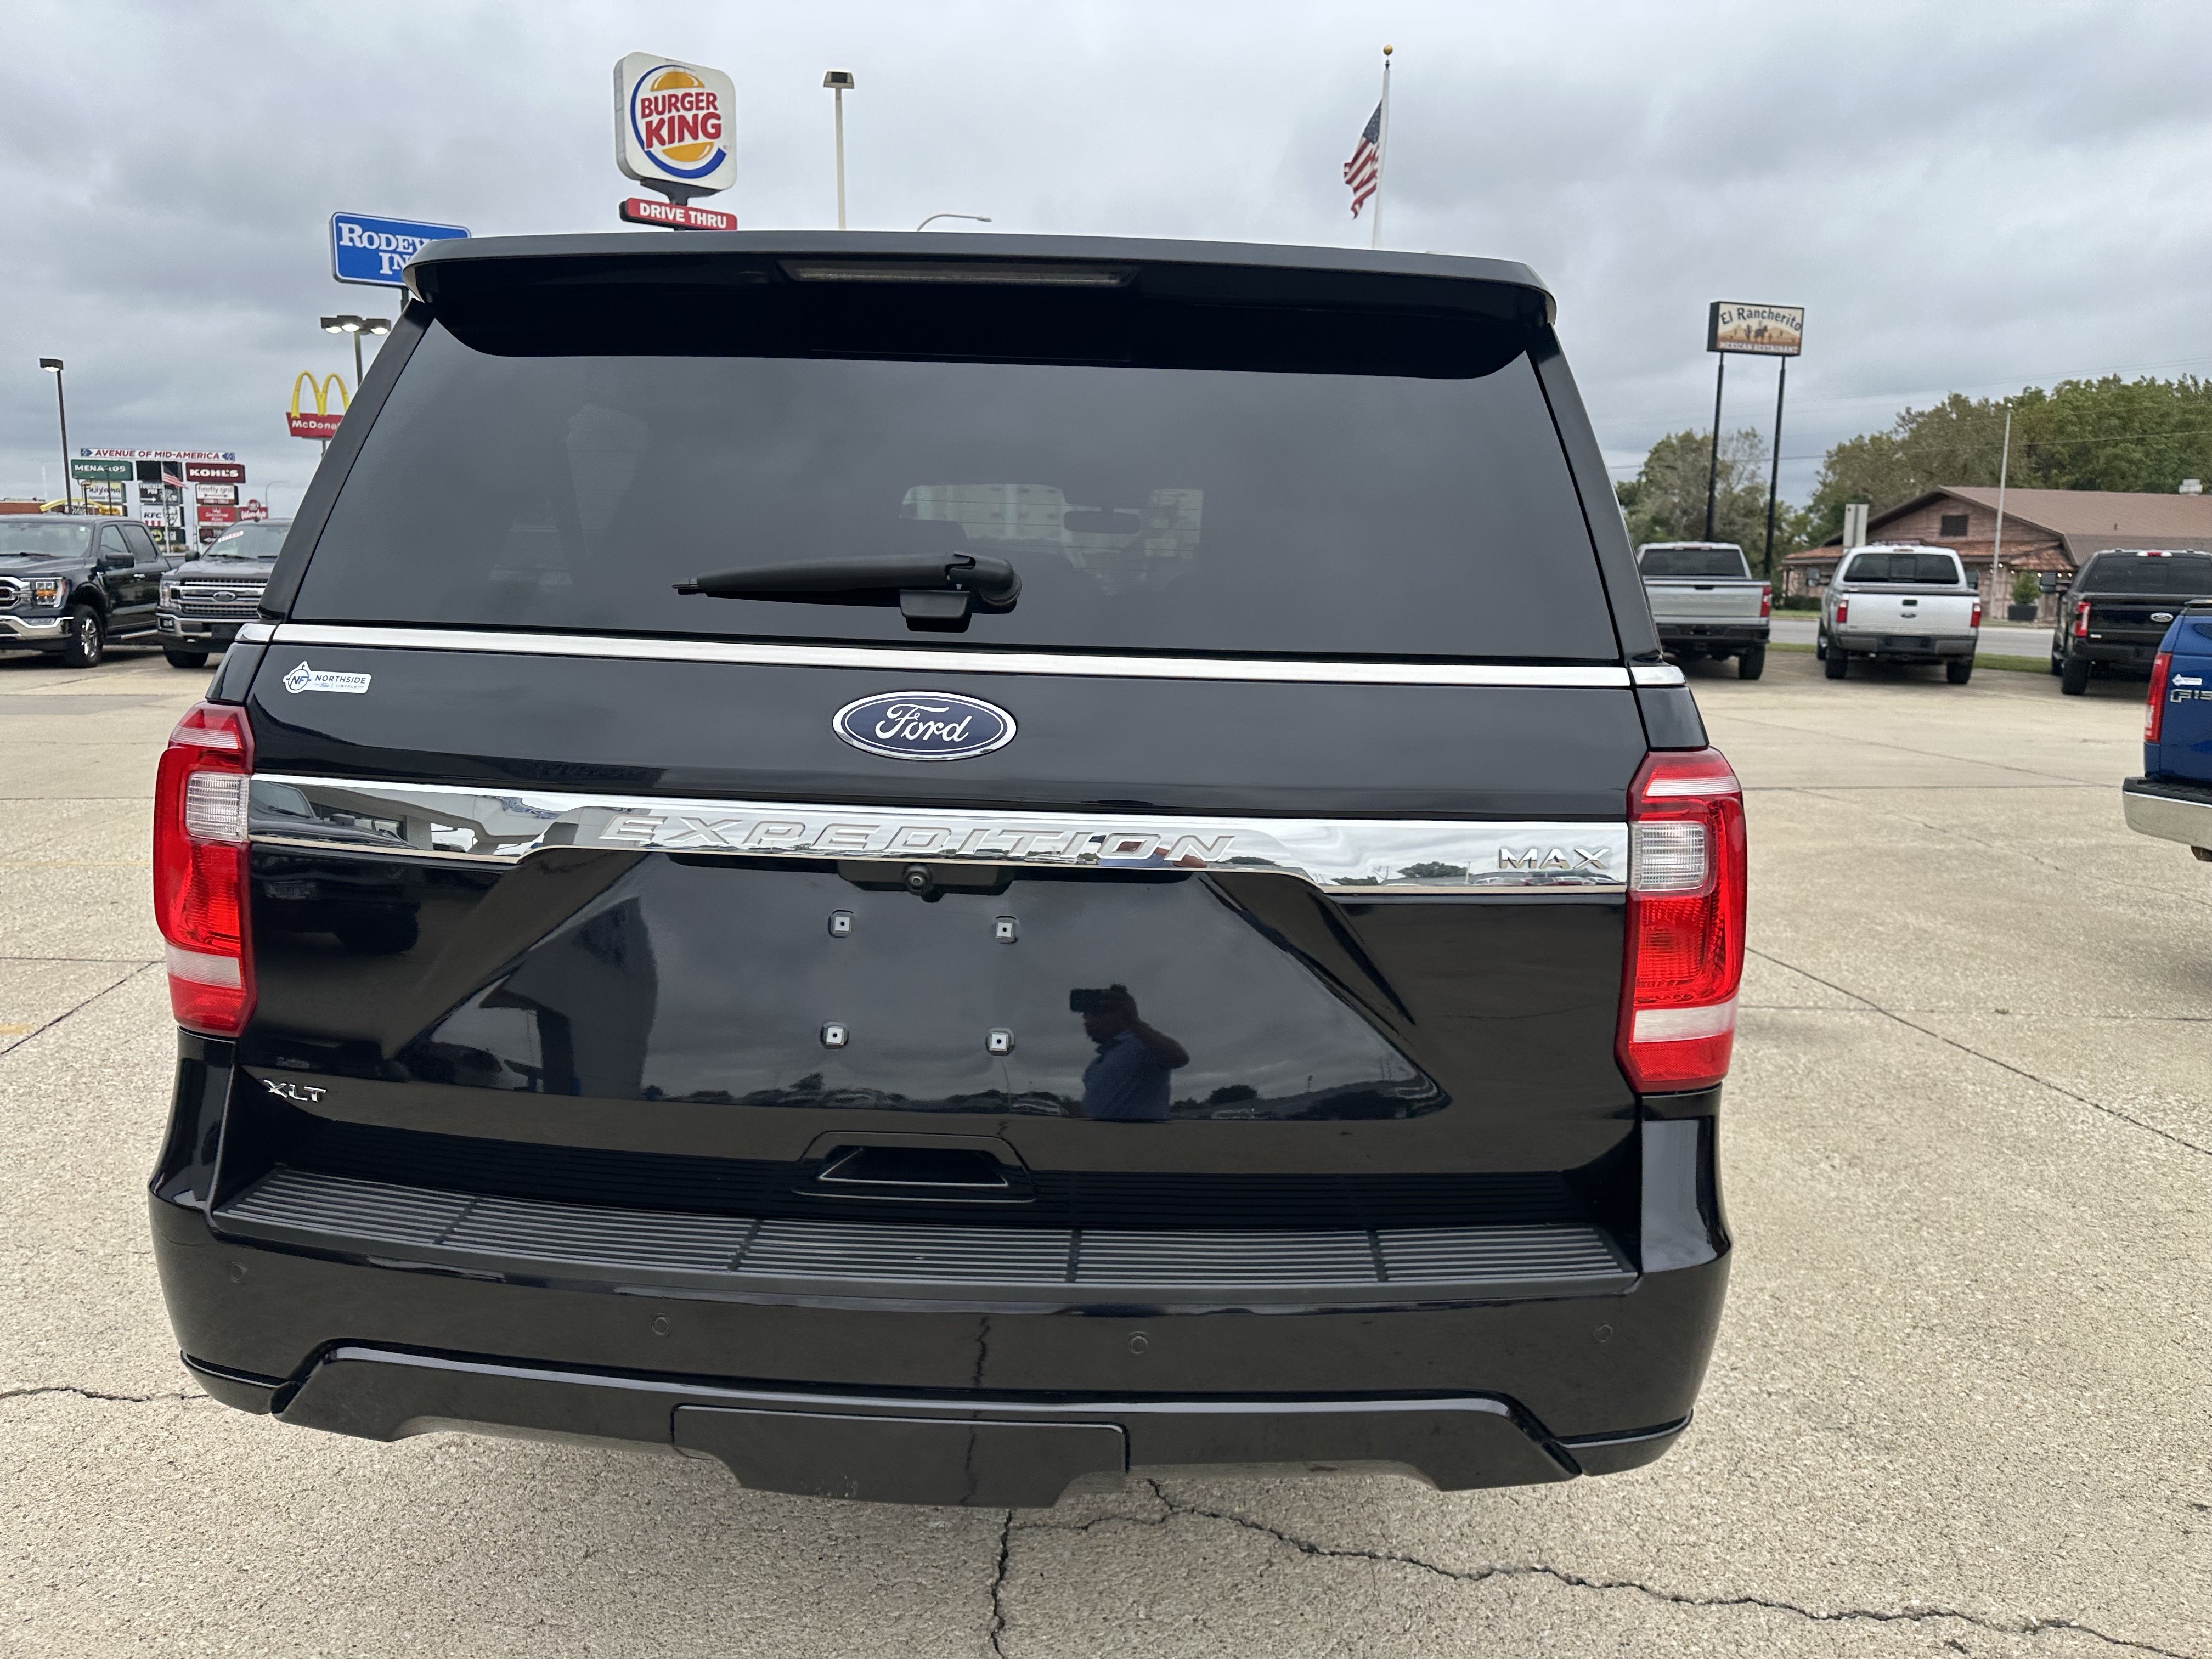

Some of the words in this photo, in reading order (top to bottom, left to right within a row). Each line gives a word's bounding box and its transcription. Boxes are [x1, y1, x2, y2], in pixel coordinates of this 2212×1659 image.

[640, 92, 718, 119] BURGER
[645, 112, 721, 149] KING
[639, 203, 685, 222] DRIVE
[689, 210, 727, 229] THRU
[1720, 311, 1733, 325] El
[1737, 307, 1802, 331] Rancherito
[154, 450, 220, 460] MID-AMERICA
[189, 469, 239, 477] KOHL'S
[315, 675, 366, 684] NORTHSIDE
[875, 703, 973, 742] Ford
[597, 812, 1236, 863] EXPEDITION
[1499, 848, 1609, 870] MAX
[264, 1079, 326, 1102] XLT
